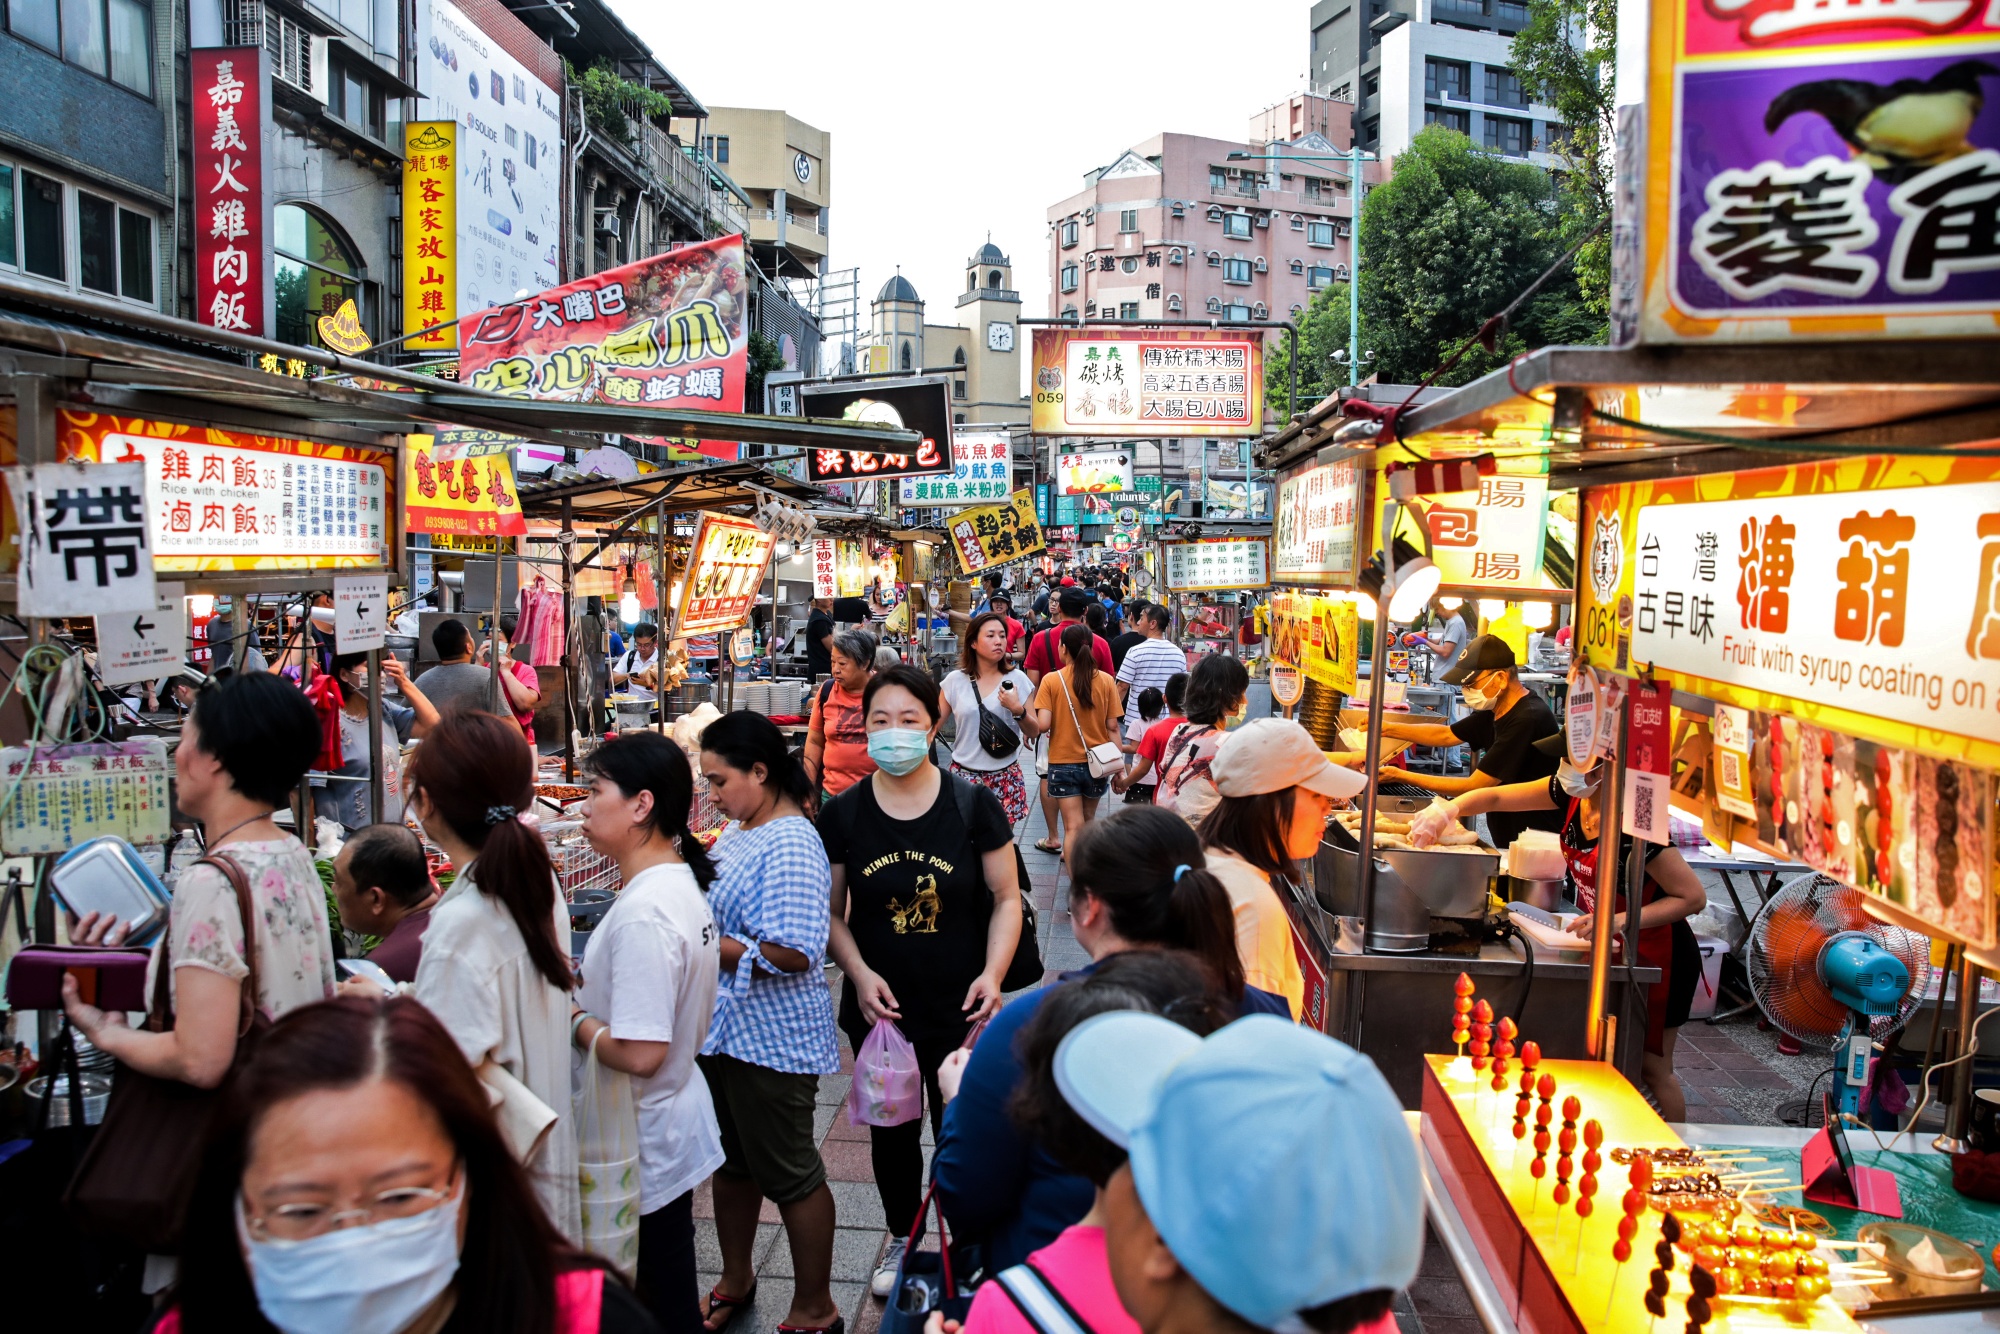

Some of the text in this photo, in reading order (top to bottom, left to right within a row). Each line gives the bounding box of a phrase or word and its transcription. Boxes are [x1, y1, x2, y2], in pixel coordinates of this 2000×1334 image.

[436, 11, 488, 59] RHINOSHIELD
[207, 59, 251, 331] 嘉義火雞肉飯
[417, 177, 447, 342] 客家放山雞莊
[531, 283, 628, 331] 大嘴巴
[1084, 346, 1123, 362] 嘉義
[1143, 348, 1244, 368] 傳統糯米腸
[1078, 363, 1125, 386] 碳烤
[1037, 392, 1064, 404] 059
[1075, 387, 1134, 417] 香腸
[1144, 399, 1244, 418] 大腸包小腸
[442, 430, 530, 443] 本空心鳳
[161, 447, 259, 488] 雞肉飯
[263, 469, 276, 489] 35
[161, 482, 260, 499] Rice with chicken
[297, 464, 307, 537] 紫菜蛋花湯
[336, 467, 346, 537] 金針排骨湯
[348, 468, 357, 537] 苦瓜排骨湯
[370, 471, 379, 538] 炒青菜
[1476, 480, 1525, 508] 腸
[162, 499, 277, 534] 滷肉飯 35
[975, 506, 1020, 538] 起司
[1424, 502, 1480, 548] 包
[45, 486, 146, 587] 帶
[161, 535, 259, 547] Rice with braised pork
[360, 541, 369, 550] 40
[371, 541, 380, 550] 40
[954, 520, 985, 568] 明太子
[988, 522, 1038, 558] 烤餅
[1172, 547, 1183, 578] 木瓜牛奶
[1187, 546, 1198, 577] 西瓜汁
[1248, 543, 1259, 575] 香蕉牛奶
[1470, 552, 1521, 580] 腸
[1641, 531, 1719, 582] 台灣
[1587, 605, 1616, 650] 061
[1638, 587, 1715, 645] 古早味
[1722, 635, 1986, 711] Fruit with syrup coating on
[862, 850, 954, 877] WINNIE THE POOH
